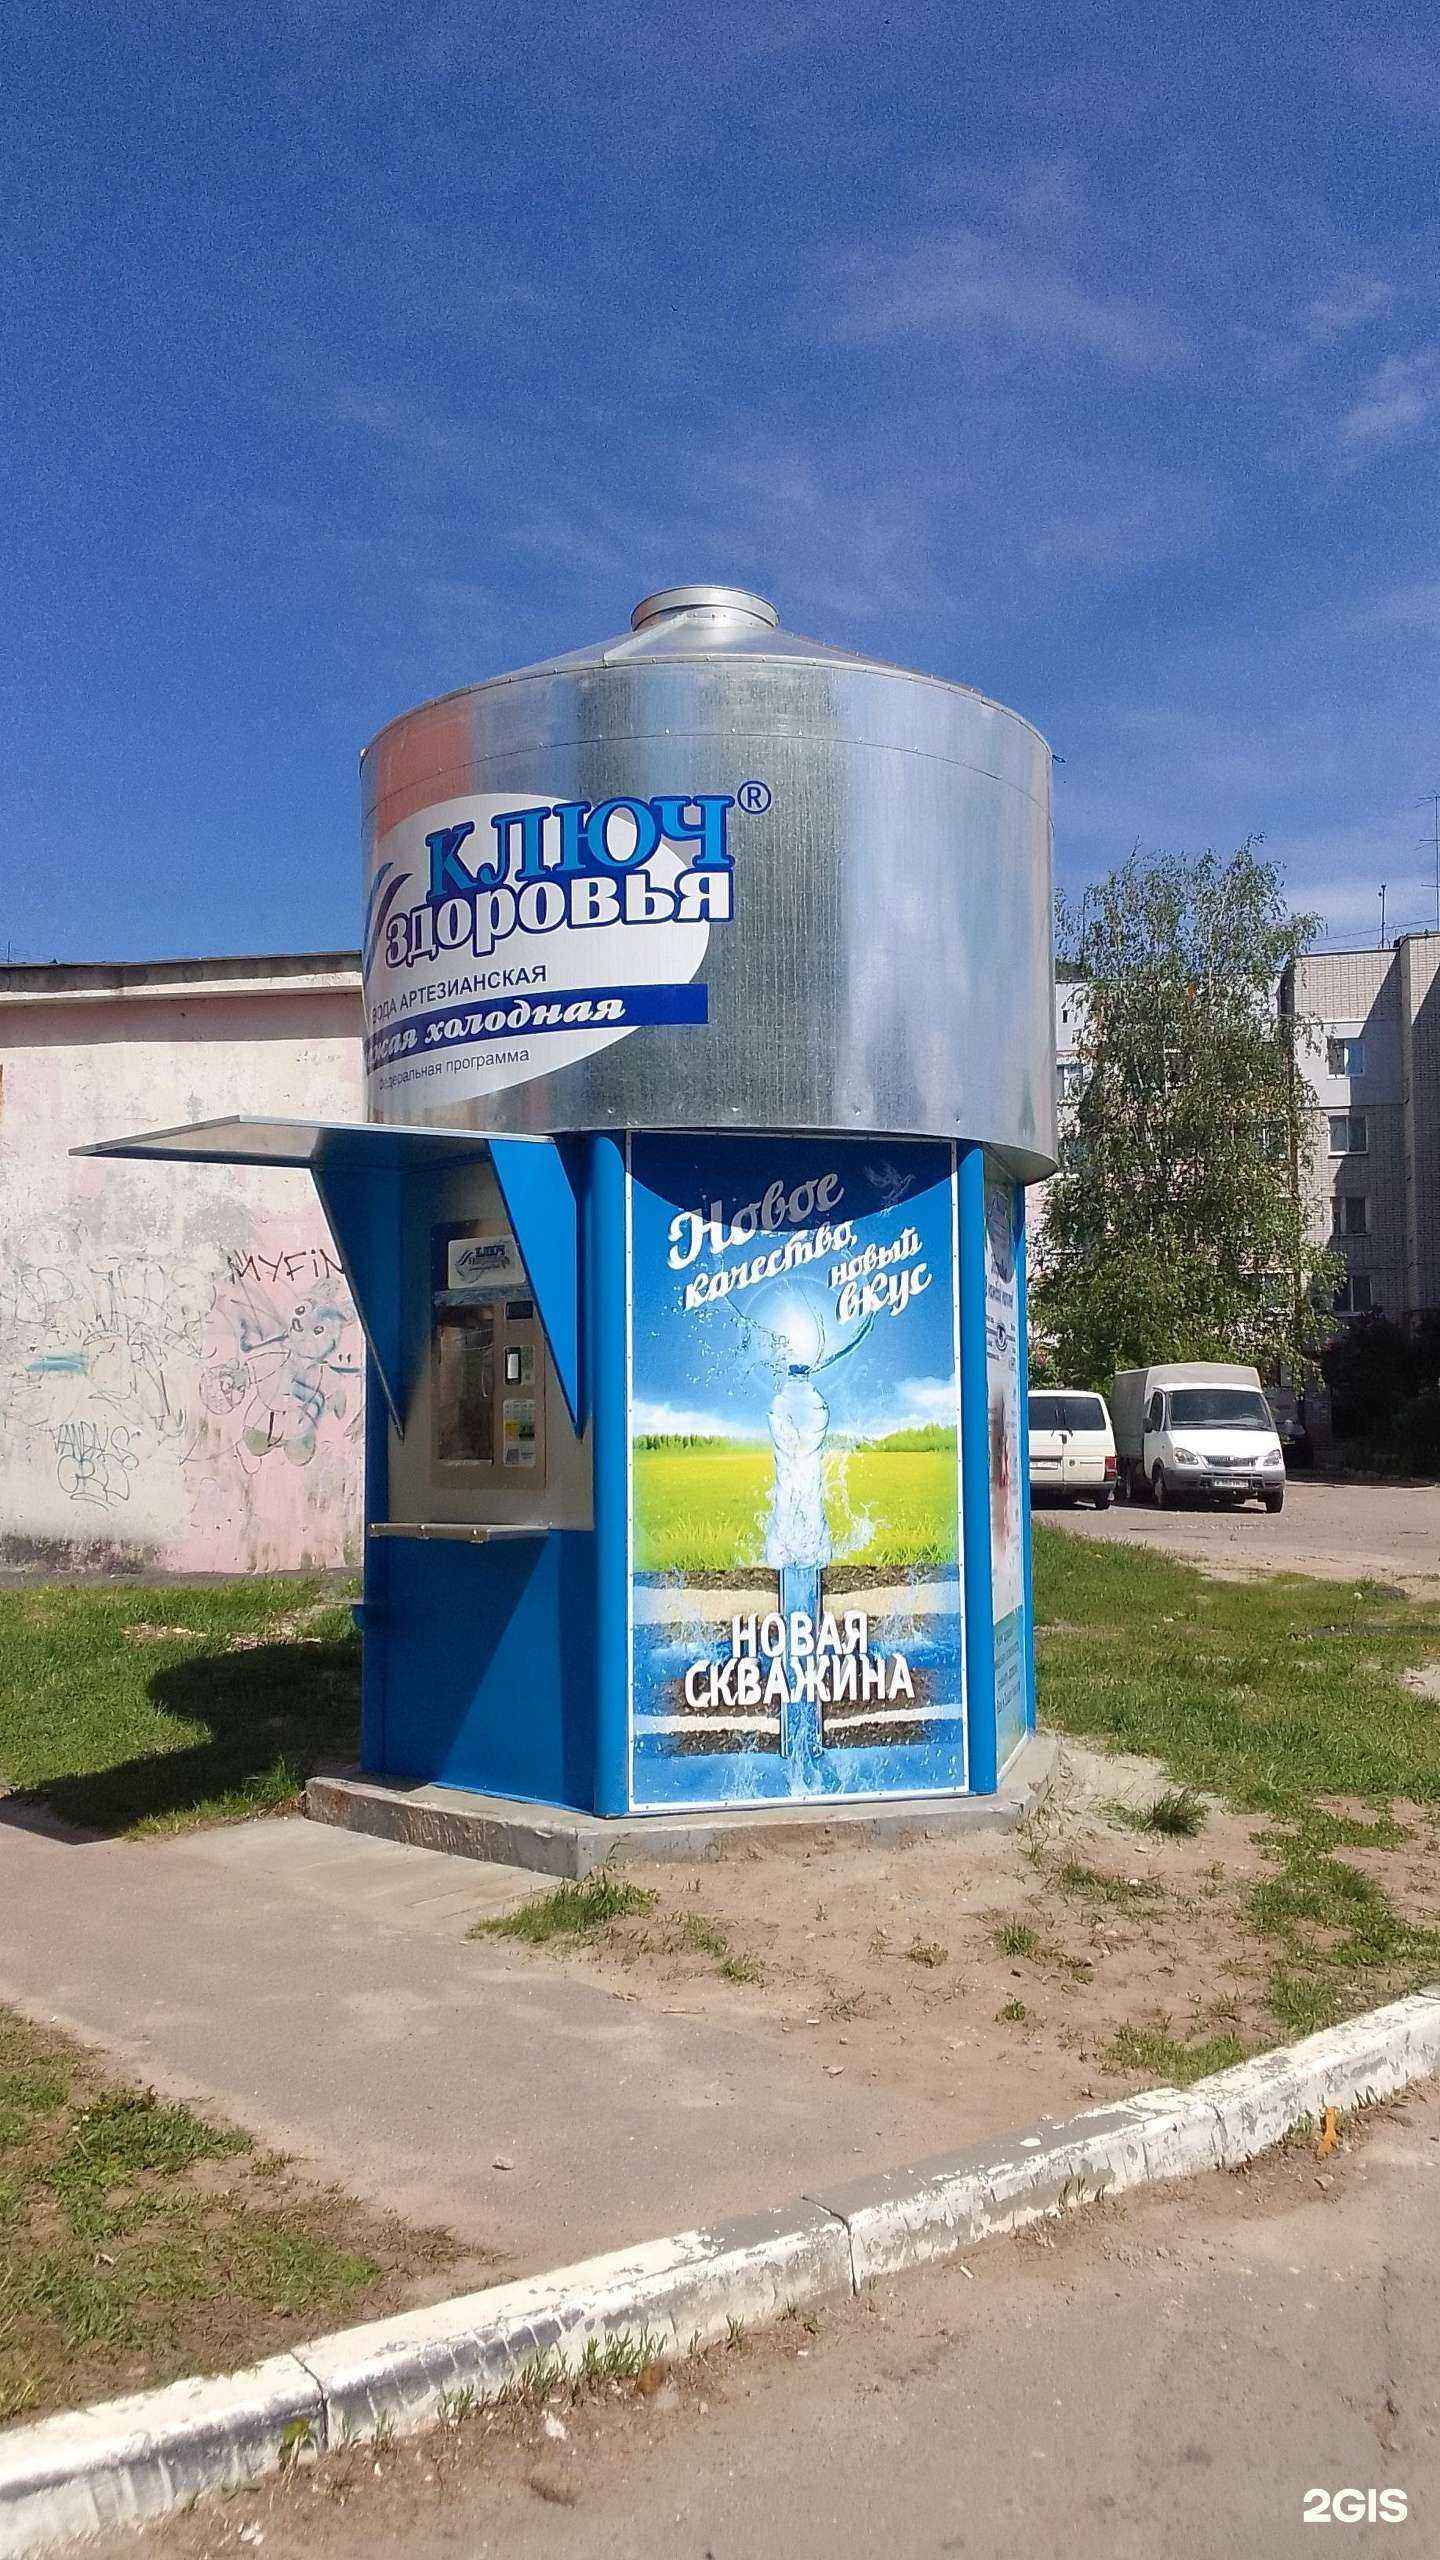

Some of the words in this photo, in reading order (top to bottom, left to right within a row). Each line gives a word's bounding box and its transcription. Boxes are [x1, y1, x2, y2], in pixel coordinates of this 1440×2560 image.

[399, 965, 548, 1011] АРТЕЗИАНСКАЯ
[424, 998, 626, 1044] холодная
[445, 1047, 530, 1075] программа
[667, 1172, 845, 1271] Новое
[682, 1220, 858, 1312] качество,
[828, 1226, 924, 1288] новый
[836, 1262, 933, 1326] вкус
[731, 1609, 869, 1659] НОВАЯ
[684, 1654, 916, 1709] СКВАЖИНА
